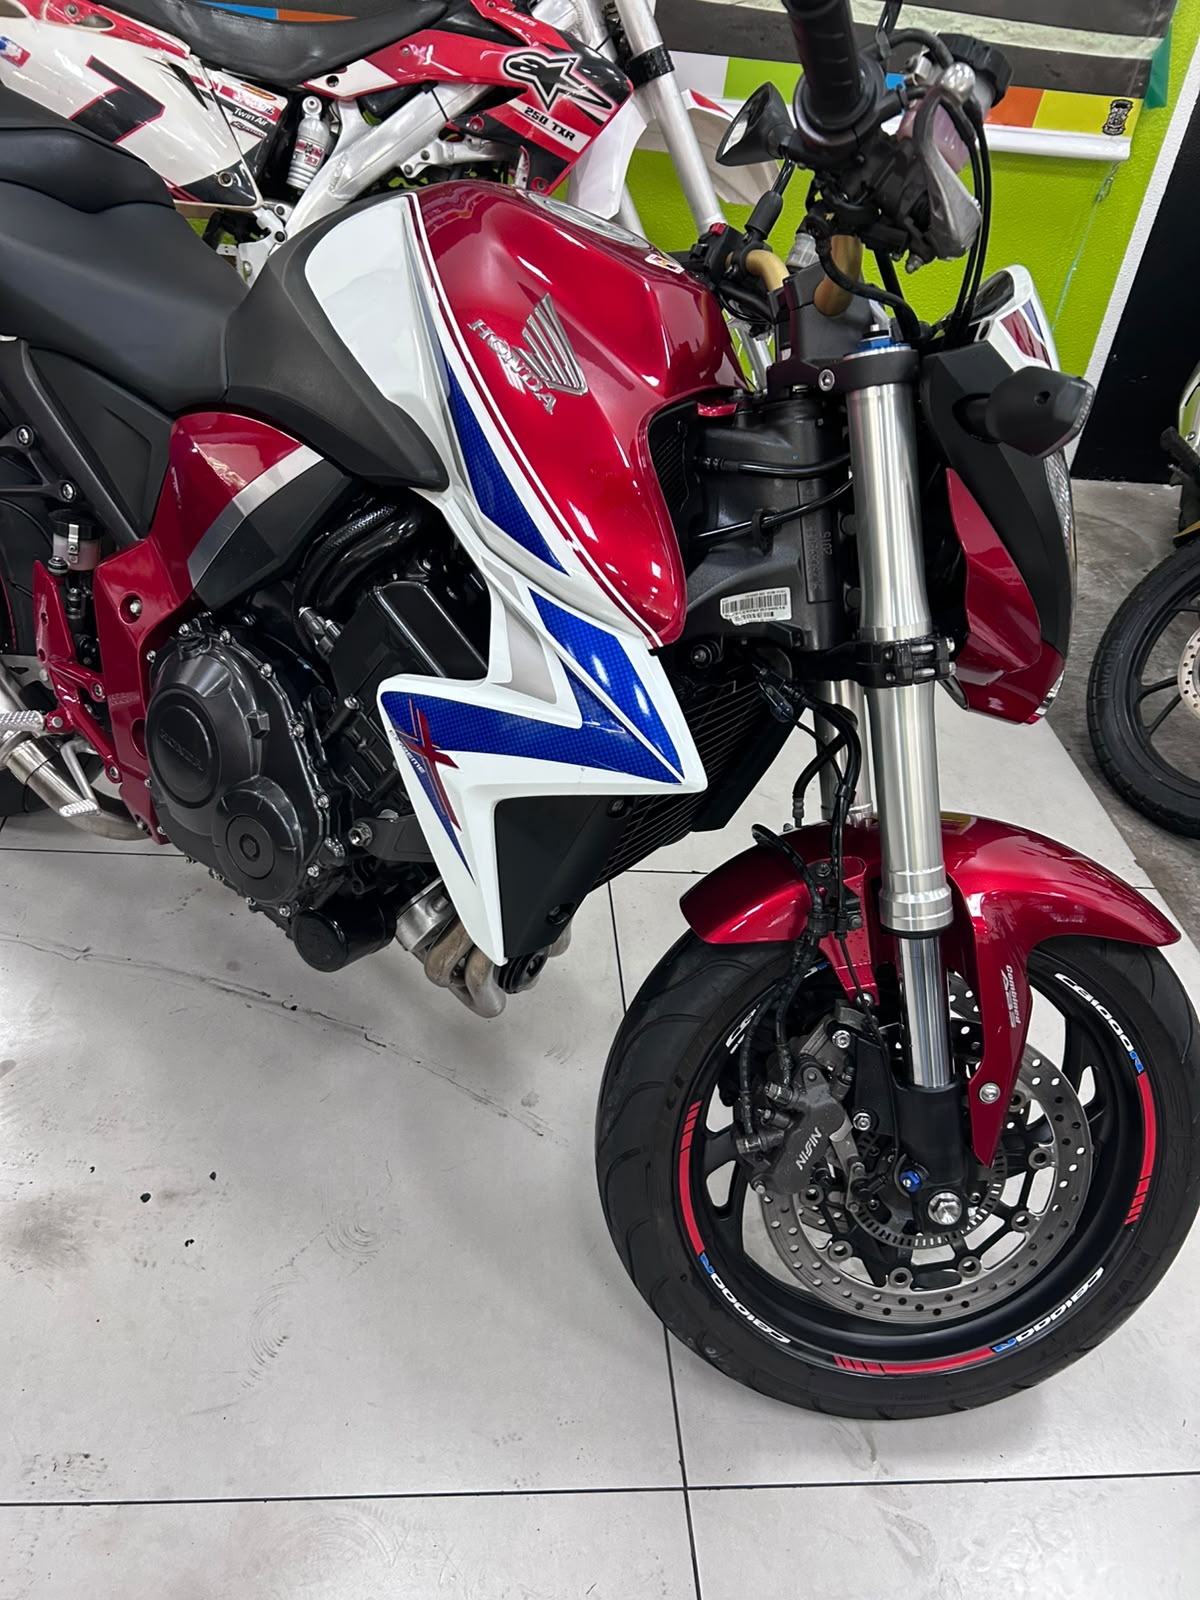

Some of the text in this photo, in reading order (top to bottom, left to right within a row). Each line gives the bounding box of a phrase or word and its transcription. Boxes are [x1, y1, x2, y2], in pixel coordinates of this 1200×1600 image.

[234, 107, 269, 126] Twin Air
[524, 106, 576, 142] 250 TXR
[467, 319, 557, 415] HONDA
[1005, 964, 1022, 1024] Combined
[1054, 973, 1145, 1074] CB1000R
[795, 1126, 822, 1171] NISSIN
[700, 1252, 792, 1344] CB1000R
[992, 1266, 1105, 1353] CB1000R
